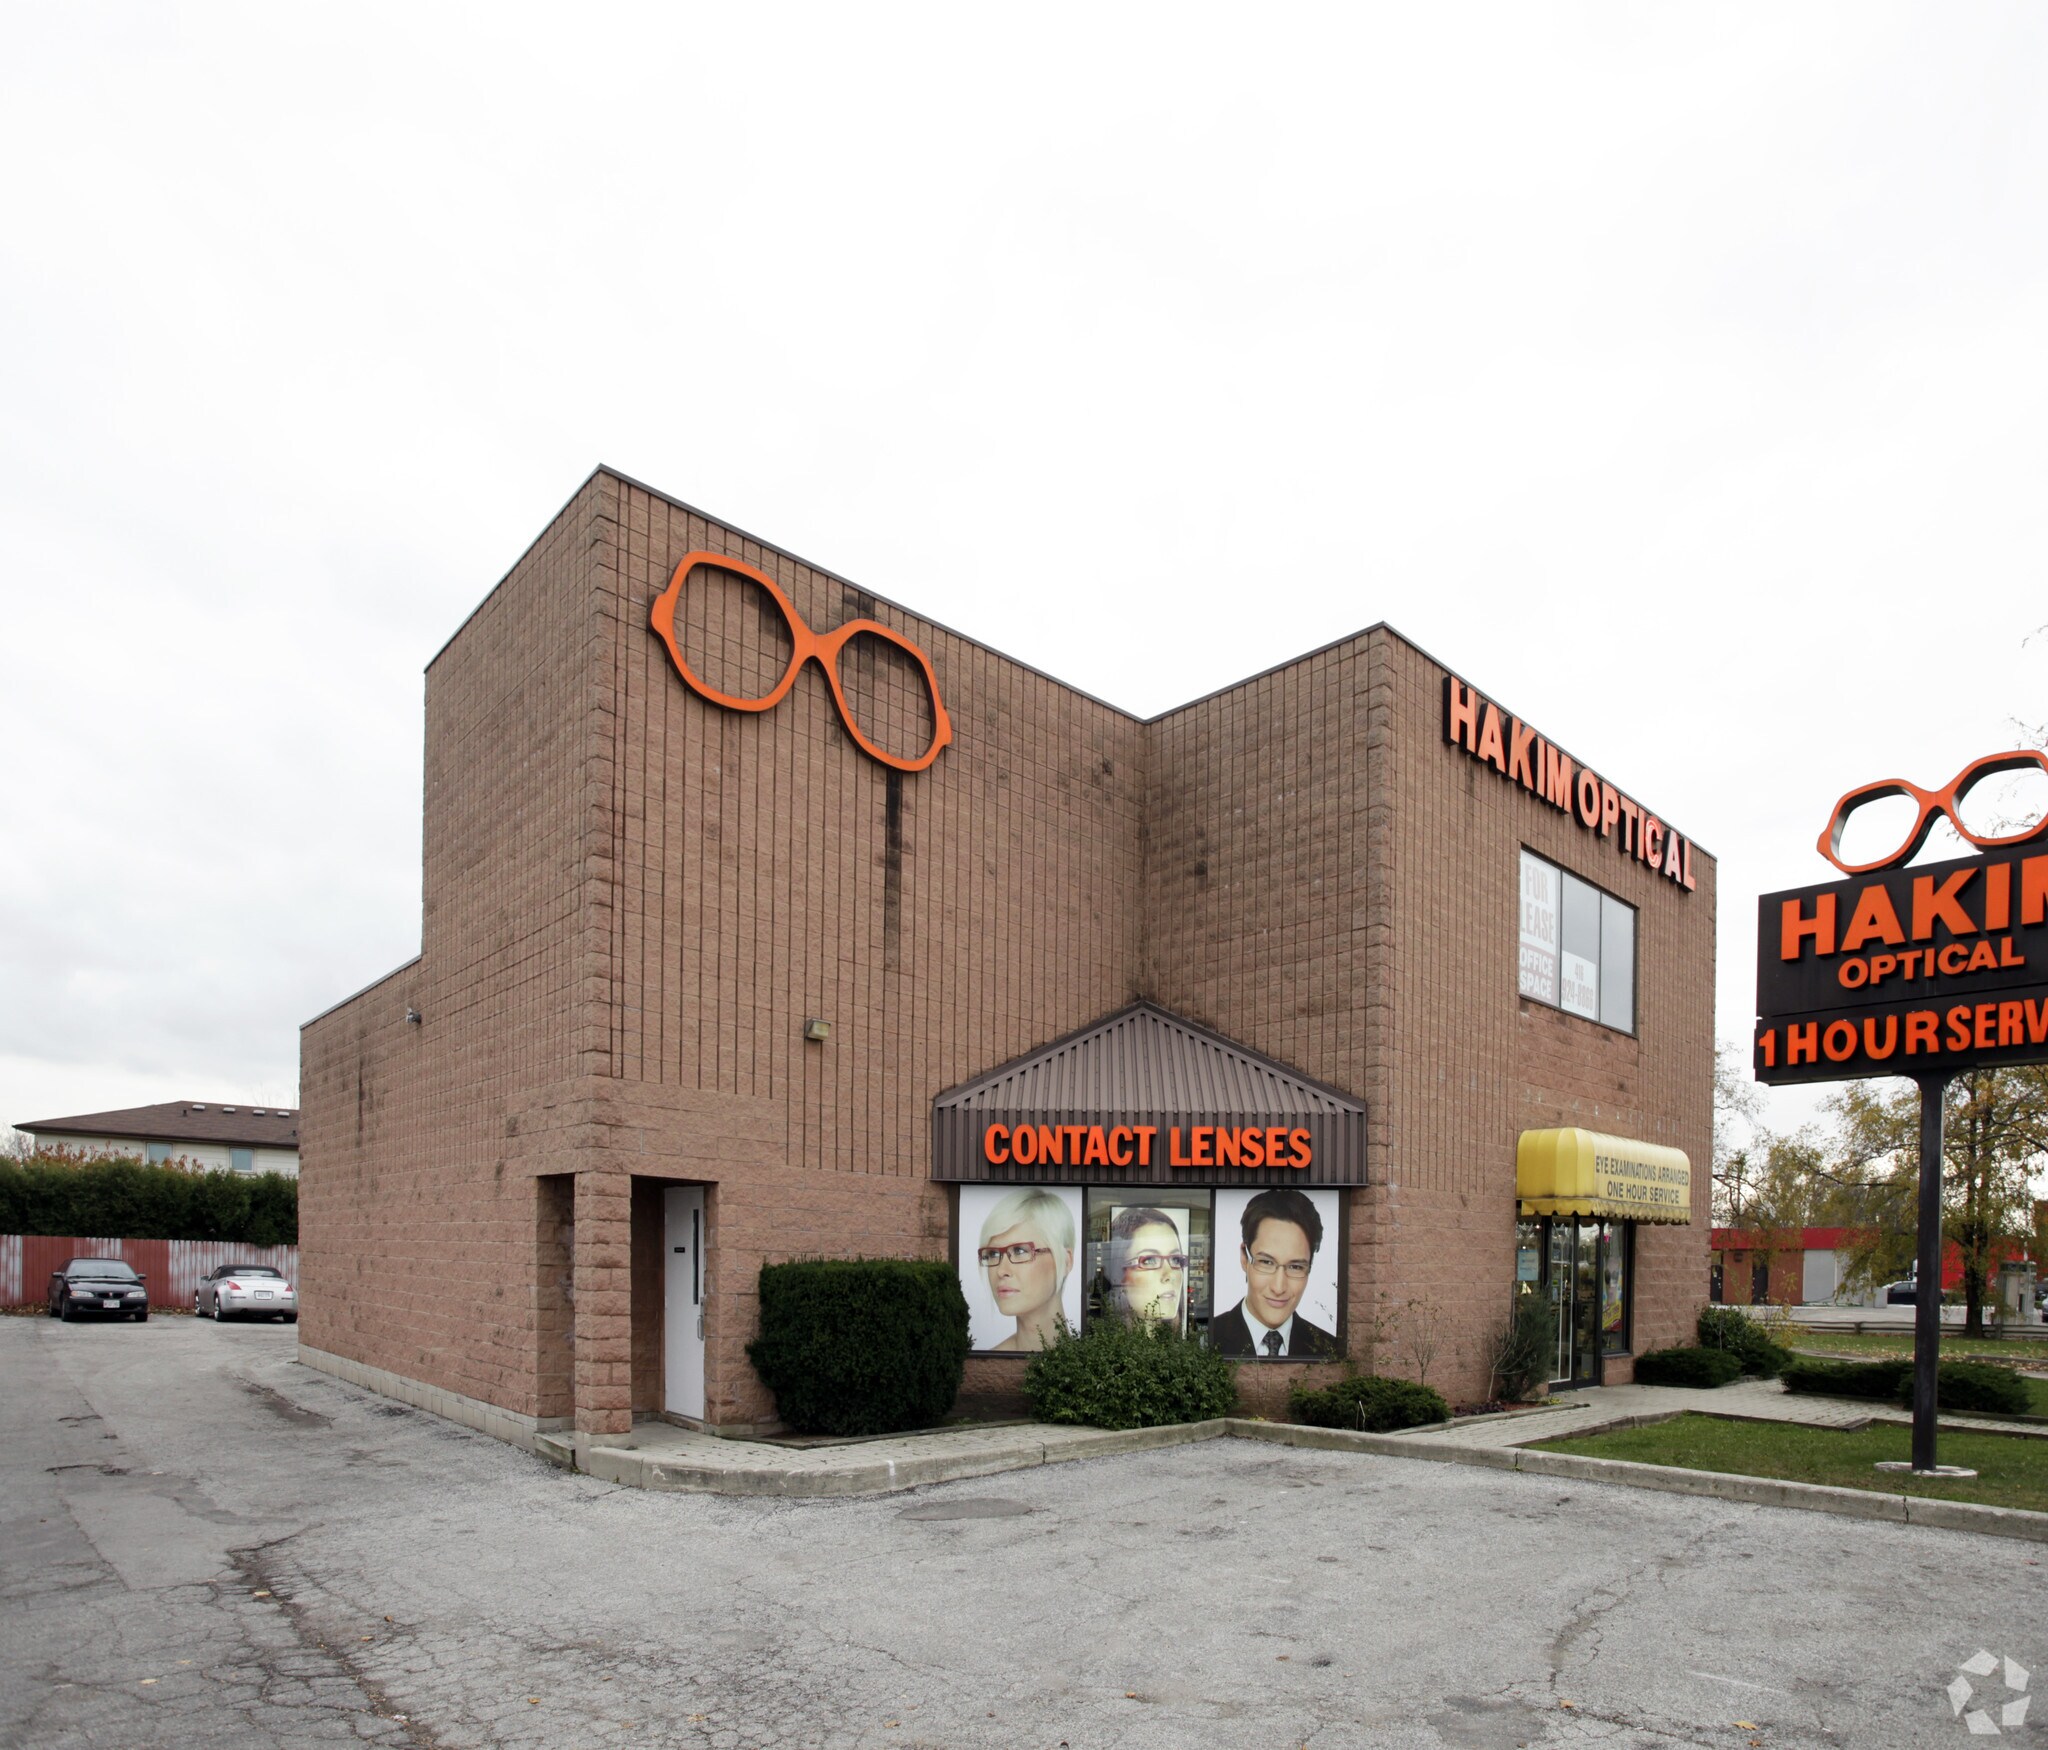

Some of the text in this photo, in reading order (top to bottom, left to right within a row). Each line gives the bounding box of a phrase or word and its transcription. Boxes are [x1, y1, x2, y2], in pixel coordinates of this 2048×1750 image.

[1445, 676, 1696, 892] HAKIM OPTICAL
[1524, 863, 1548, 904] FOR
[1520, 947, 1553, 978] OFFICE
[1838, 936, 2025, 988] OPTICAL
[1519, 970, 1552, 1000] SPACE
[1759, 1029, 1775, 1067] 1
[1787, 1010, 1940, 1065] HOUR
[984, 1123, 1312, 1169] CONTACT LENSES
[1595, 1155, 1689, 1187] EYE EXAMINATIONS ARRANGED
[1607, 1180, 1680, 1204] ONE HOUR SERVICE
